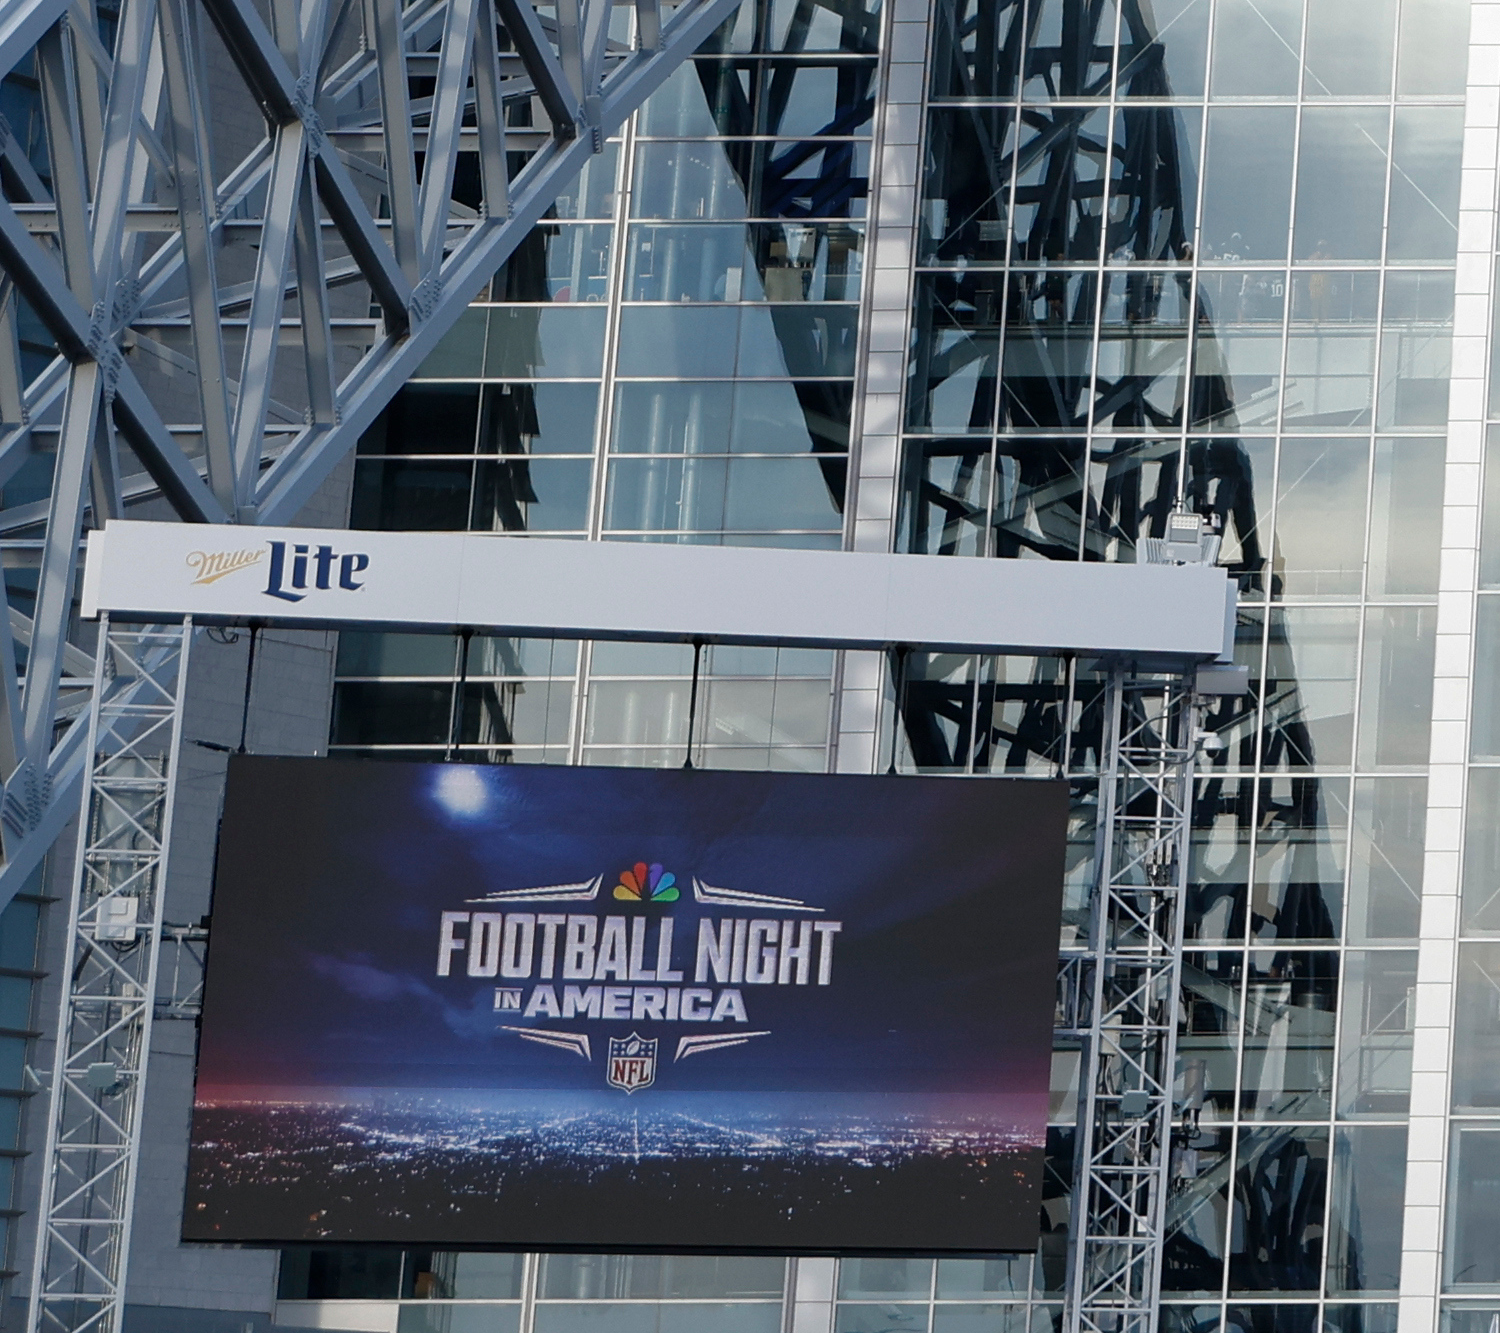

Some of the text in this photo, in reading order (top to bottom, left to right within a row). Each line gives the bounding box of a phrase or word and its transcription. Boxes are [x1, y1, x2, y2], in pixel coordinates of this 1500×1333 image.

[185, 540, 370, 603] Miller Lite
[436, 910, 843, 986] FOOTBALL NIGHT
[493, 984, 749, 1023] IN AMERICA
[612, 1059, 650, 1086] NFL
